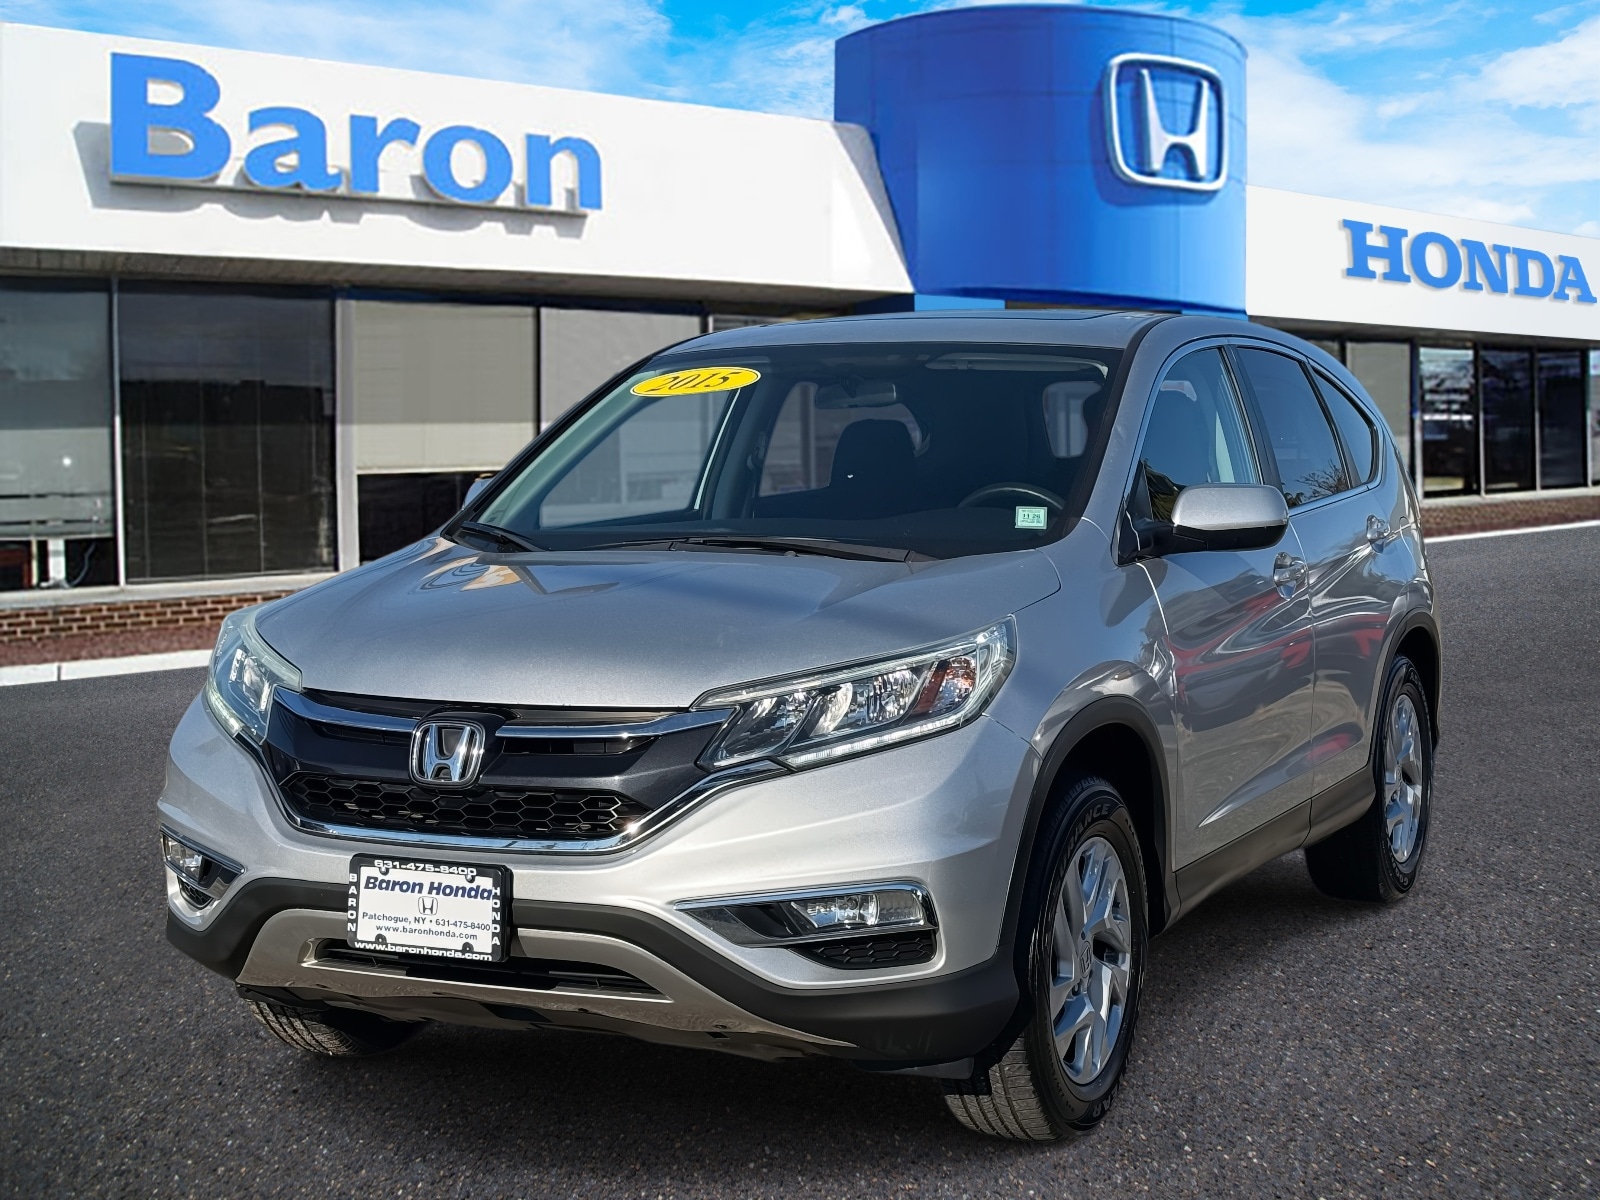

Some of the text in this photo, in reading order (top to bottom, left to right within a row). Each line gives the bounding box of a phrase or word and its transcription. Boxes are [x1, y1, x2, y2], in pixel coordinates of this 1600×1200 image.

[111, 52, 602, 211] Baron
[1342, 218, 1598, 304] HONDA
[644, 371, 741, 393] 2015
[374, 859, 477, 877] 631-475-8400
[364, 875, 493, 901] Baron Honda
[347, 873, 357, 932] BARON
[362, 911, 491, 932] Patchogue, NY 631-475-8400
[491, 886, 501, 946] HONDA
[375, 924, 478, 941] www.baronhonda.com
[354, 941, 493, 962] www.baronhonda.com
